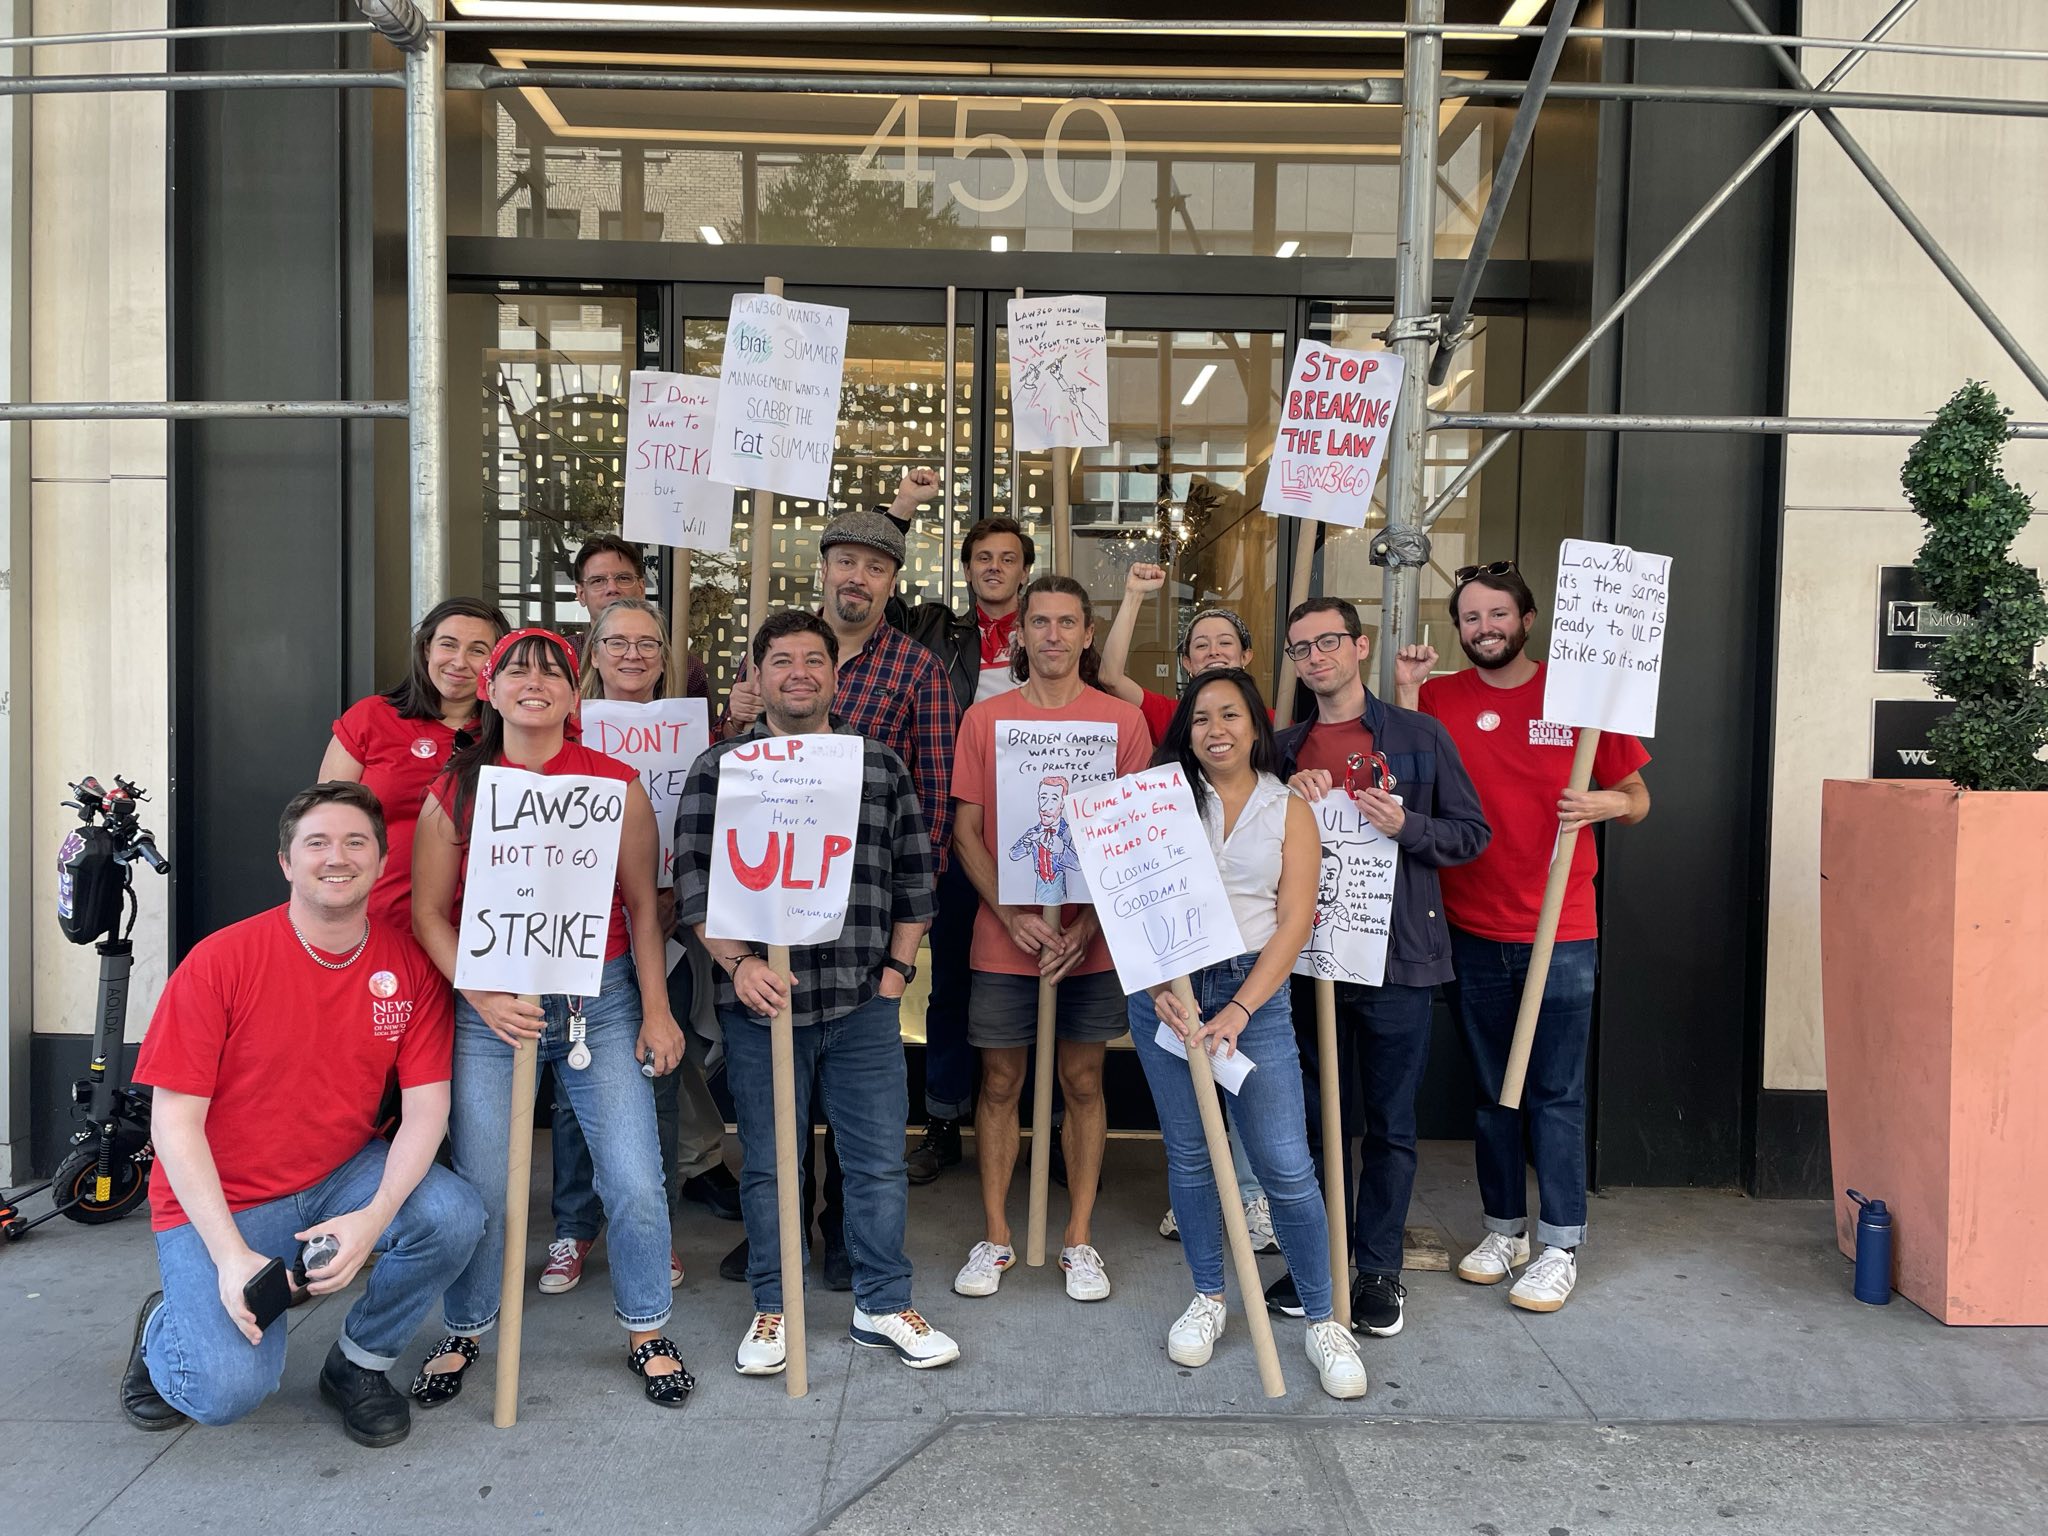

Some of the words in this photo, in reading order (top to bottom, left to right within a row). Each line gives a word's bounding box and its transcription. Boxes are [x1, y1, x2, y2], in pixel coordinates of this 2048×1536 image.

[851, 94, 1126, 214] 450
[737, 301, 782, 316] LAW360
[786, 308, 821, 324] WANTS
[825, 314, 833, 327] A
[1015, 308, 1052, 322] LAW360
[739, 328, 768, 353] brat
[784, 338, 839, 366] SUMMER
[1065, 337, 1080, 346] THE
[1300, 351, 1379, 384] STOP
[640, 382, 658, 404] I
[667, 384, 710, 406] Don't
[728, 371, 793, 393] MANAGEMENT
[795, 380, 821, 397] WANTS
[824, 386, 829, 398] A
[647, 413, 676, 429] Want
[684, 414, 699, 430] To
[747, 396, 792, 422] SCABBY
[795, 406, 813, 426] THE
[1288, 390, 1391, 428] BREAKING
[733, 427, 764, 456] rat
[770, 434, 829, 465] SUMMER
[1281, 428, 1322, 454] THE
[1327, 429, 1376, 458] LAW
[1281, 460, 1370, 496] Law360
[673, 501, 683, 513] I
[683, 518, 706, 536] Will
[1562, 541, 1632, 573] Law360
[1642, 560, 1667, 585] and
[1559, 571, 1577, 589] it's
[1593, 574, 1622, 594] the
[1631, 583, 1666, 605] same
[1557, 592, 1581, 611] but
[1615, 602, 1645, 621] union
[1652, 607, 1665, 625] is
[1896, 610, 1915, 627] M
[1554, 616, 1595, 639] ready
[1607, 619, 1624, 637] to
[1632, 625, 1662, 643] ULP
[1637, 654, 1660, 673] not
[593, 719, 689, 755] DON'T
[1008, 728, 1062, 746] BRADEN
[1066, 731, 1118, 746] CAMPBELL
[1528, 728, 1573, 739] GUILD
[1529, 737, 1574, 748] MEMBER
[1028, 748, 1070, 757] WANTS
[1075, 745, 1104, 757] YOU!
[1018, 760, 1037, 774] (TO
[1042, 761, 1091, 772] PRACTICE
[1071, 768, 1117, 784] PICKET)
[490, 783, 622, 832] LAW360
[1072, 798, 1080, 820] I
[1080, 795, 1120, 819] CHIME
[1171, 771, 1183, 788] A
[1102, 836, 1142, 861] HEARD
[1147, 825, 1168, 843] OF
[490, 844, 537, 867] HOT
[543, 845, 564, 867] TO
[572, 848, 598, 869] GO
[726, 828, 853, 892] ULP
[1100, 858, 1160, 891] CLOSING
[1163, 844, 1186, 860] THE
[1347, 855, 1393, 869] LAW360
[1348, 880, 1366, 888] OUR
[1350, 868, 1388, 883] UNION,
[516, 887, 535, 898] on
[1350, 902, 1368, 910] HAS
[470, 909, 604, 960] STRIKE
